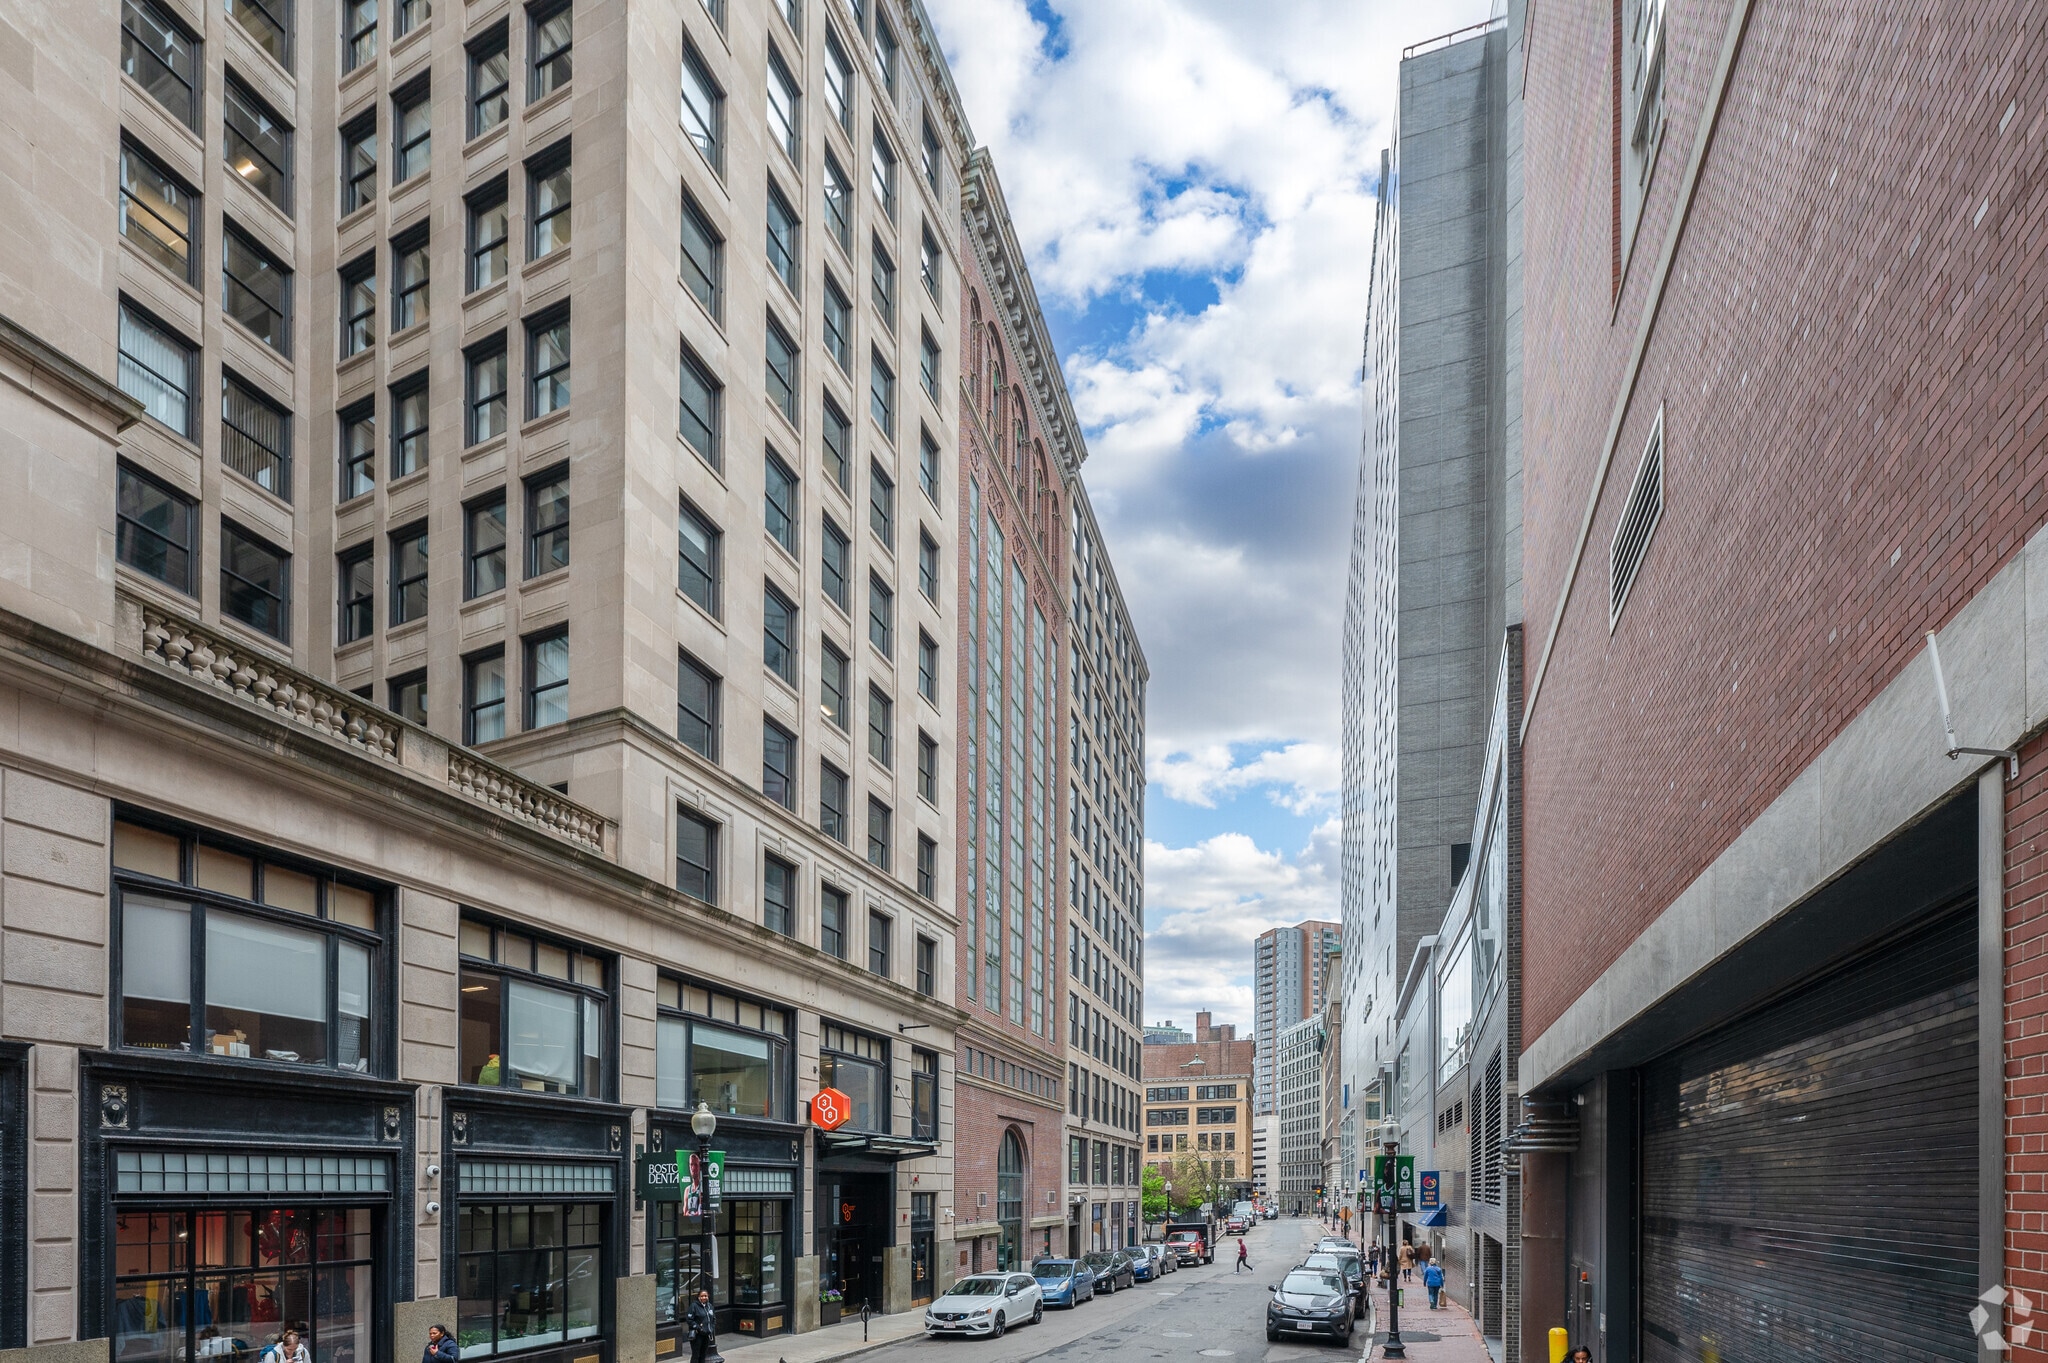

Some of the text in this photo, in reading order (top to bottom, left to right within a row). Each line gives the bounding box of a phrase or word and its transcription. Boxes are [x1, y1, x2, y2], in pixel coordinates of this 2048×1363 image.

[822, 1099, 827, 1107] 3
[827, 1111, 833, 1119] 8
[648, 1163, 679, 1174] BOSTO
[648, 1173, 680, 1184] DENTA
